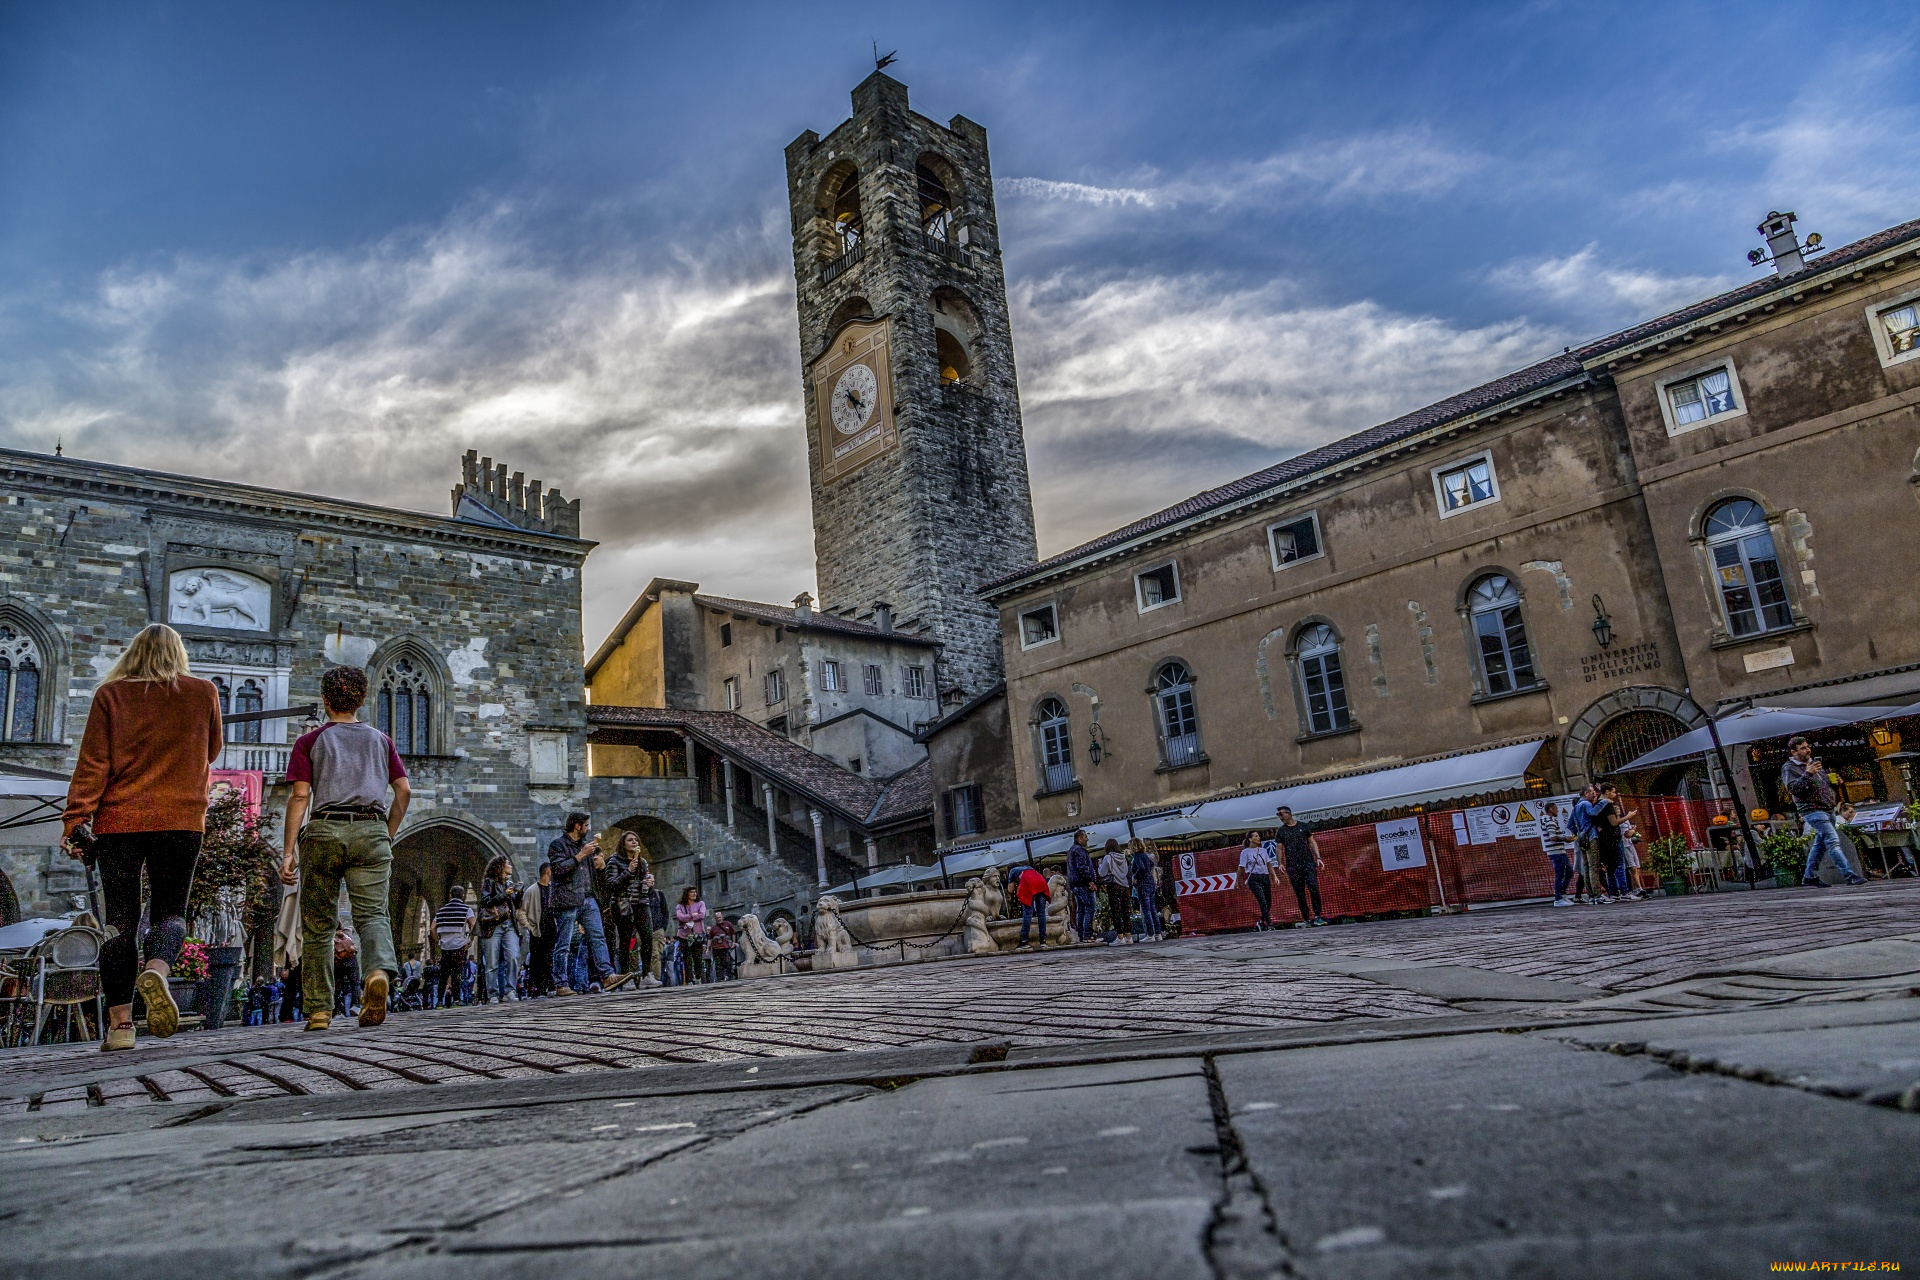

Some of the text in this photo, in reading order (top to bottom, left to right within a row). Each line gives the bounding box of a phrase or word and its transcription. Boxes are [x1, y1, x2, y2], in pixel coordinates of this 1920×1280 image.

[1583, 650, 1660, 674] DEGLI STUDI
[1584, 660, 1661, 682] DI BERGAMO
[1380, 828, 1409, 840] ecoedile
